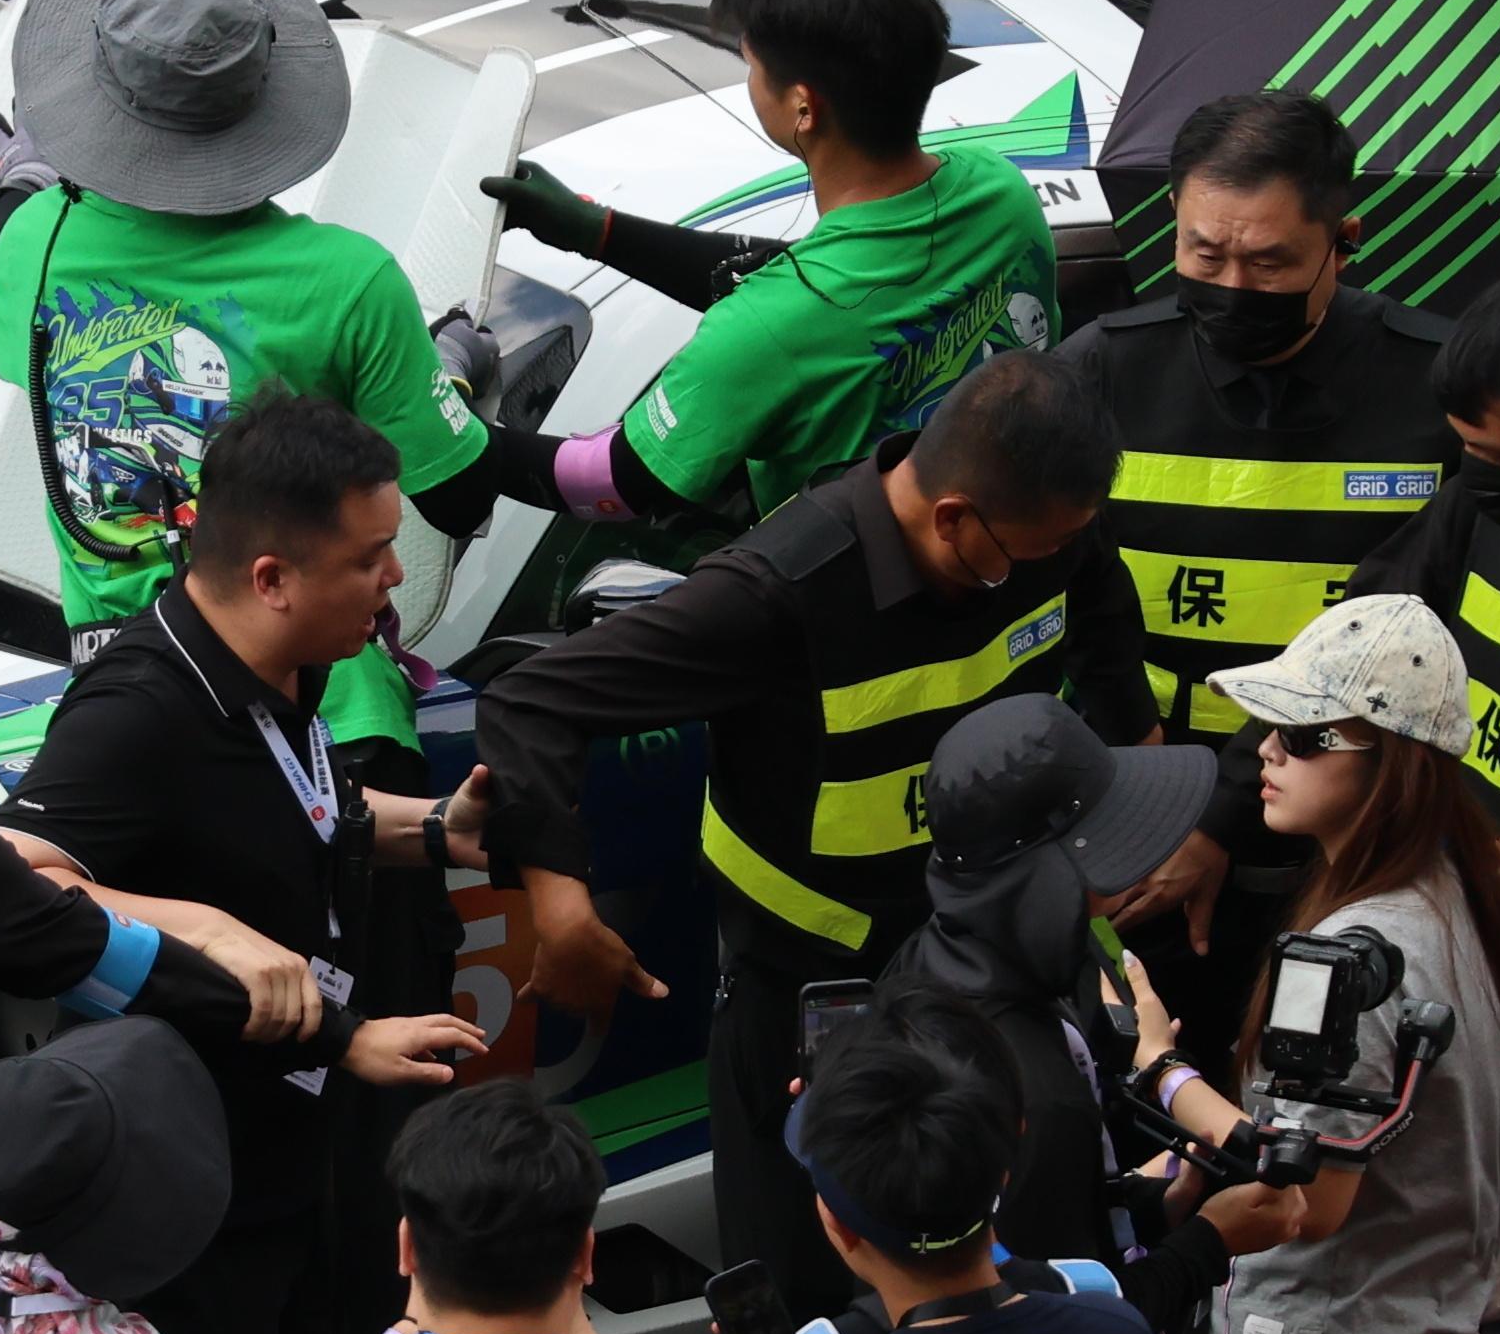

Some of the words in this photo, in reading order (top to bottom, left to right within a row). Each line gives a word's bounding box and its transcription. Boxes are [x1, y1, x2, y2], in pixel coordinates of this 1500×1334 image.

[1347, 481, 1389, 496] GRID
[1395, 481, 1435, 496] GRID
[1009, 633, 1039, 657] GRID
[1038, 616, 1062, 640] GRID
[1370, 1110, 1414, 1155] RONIN
